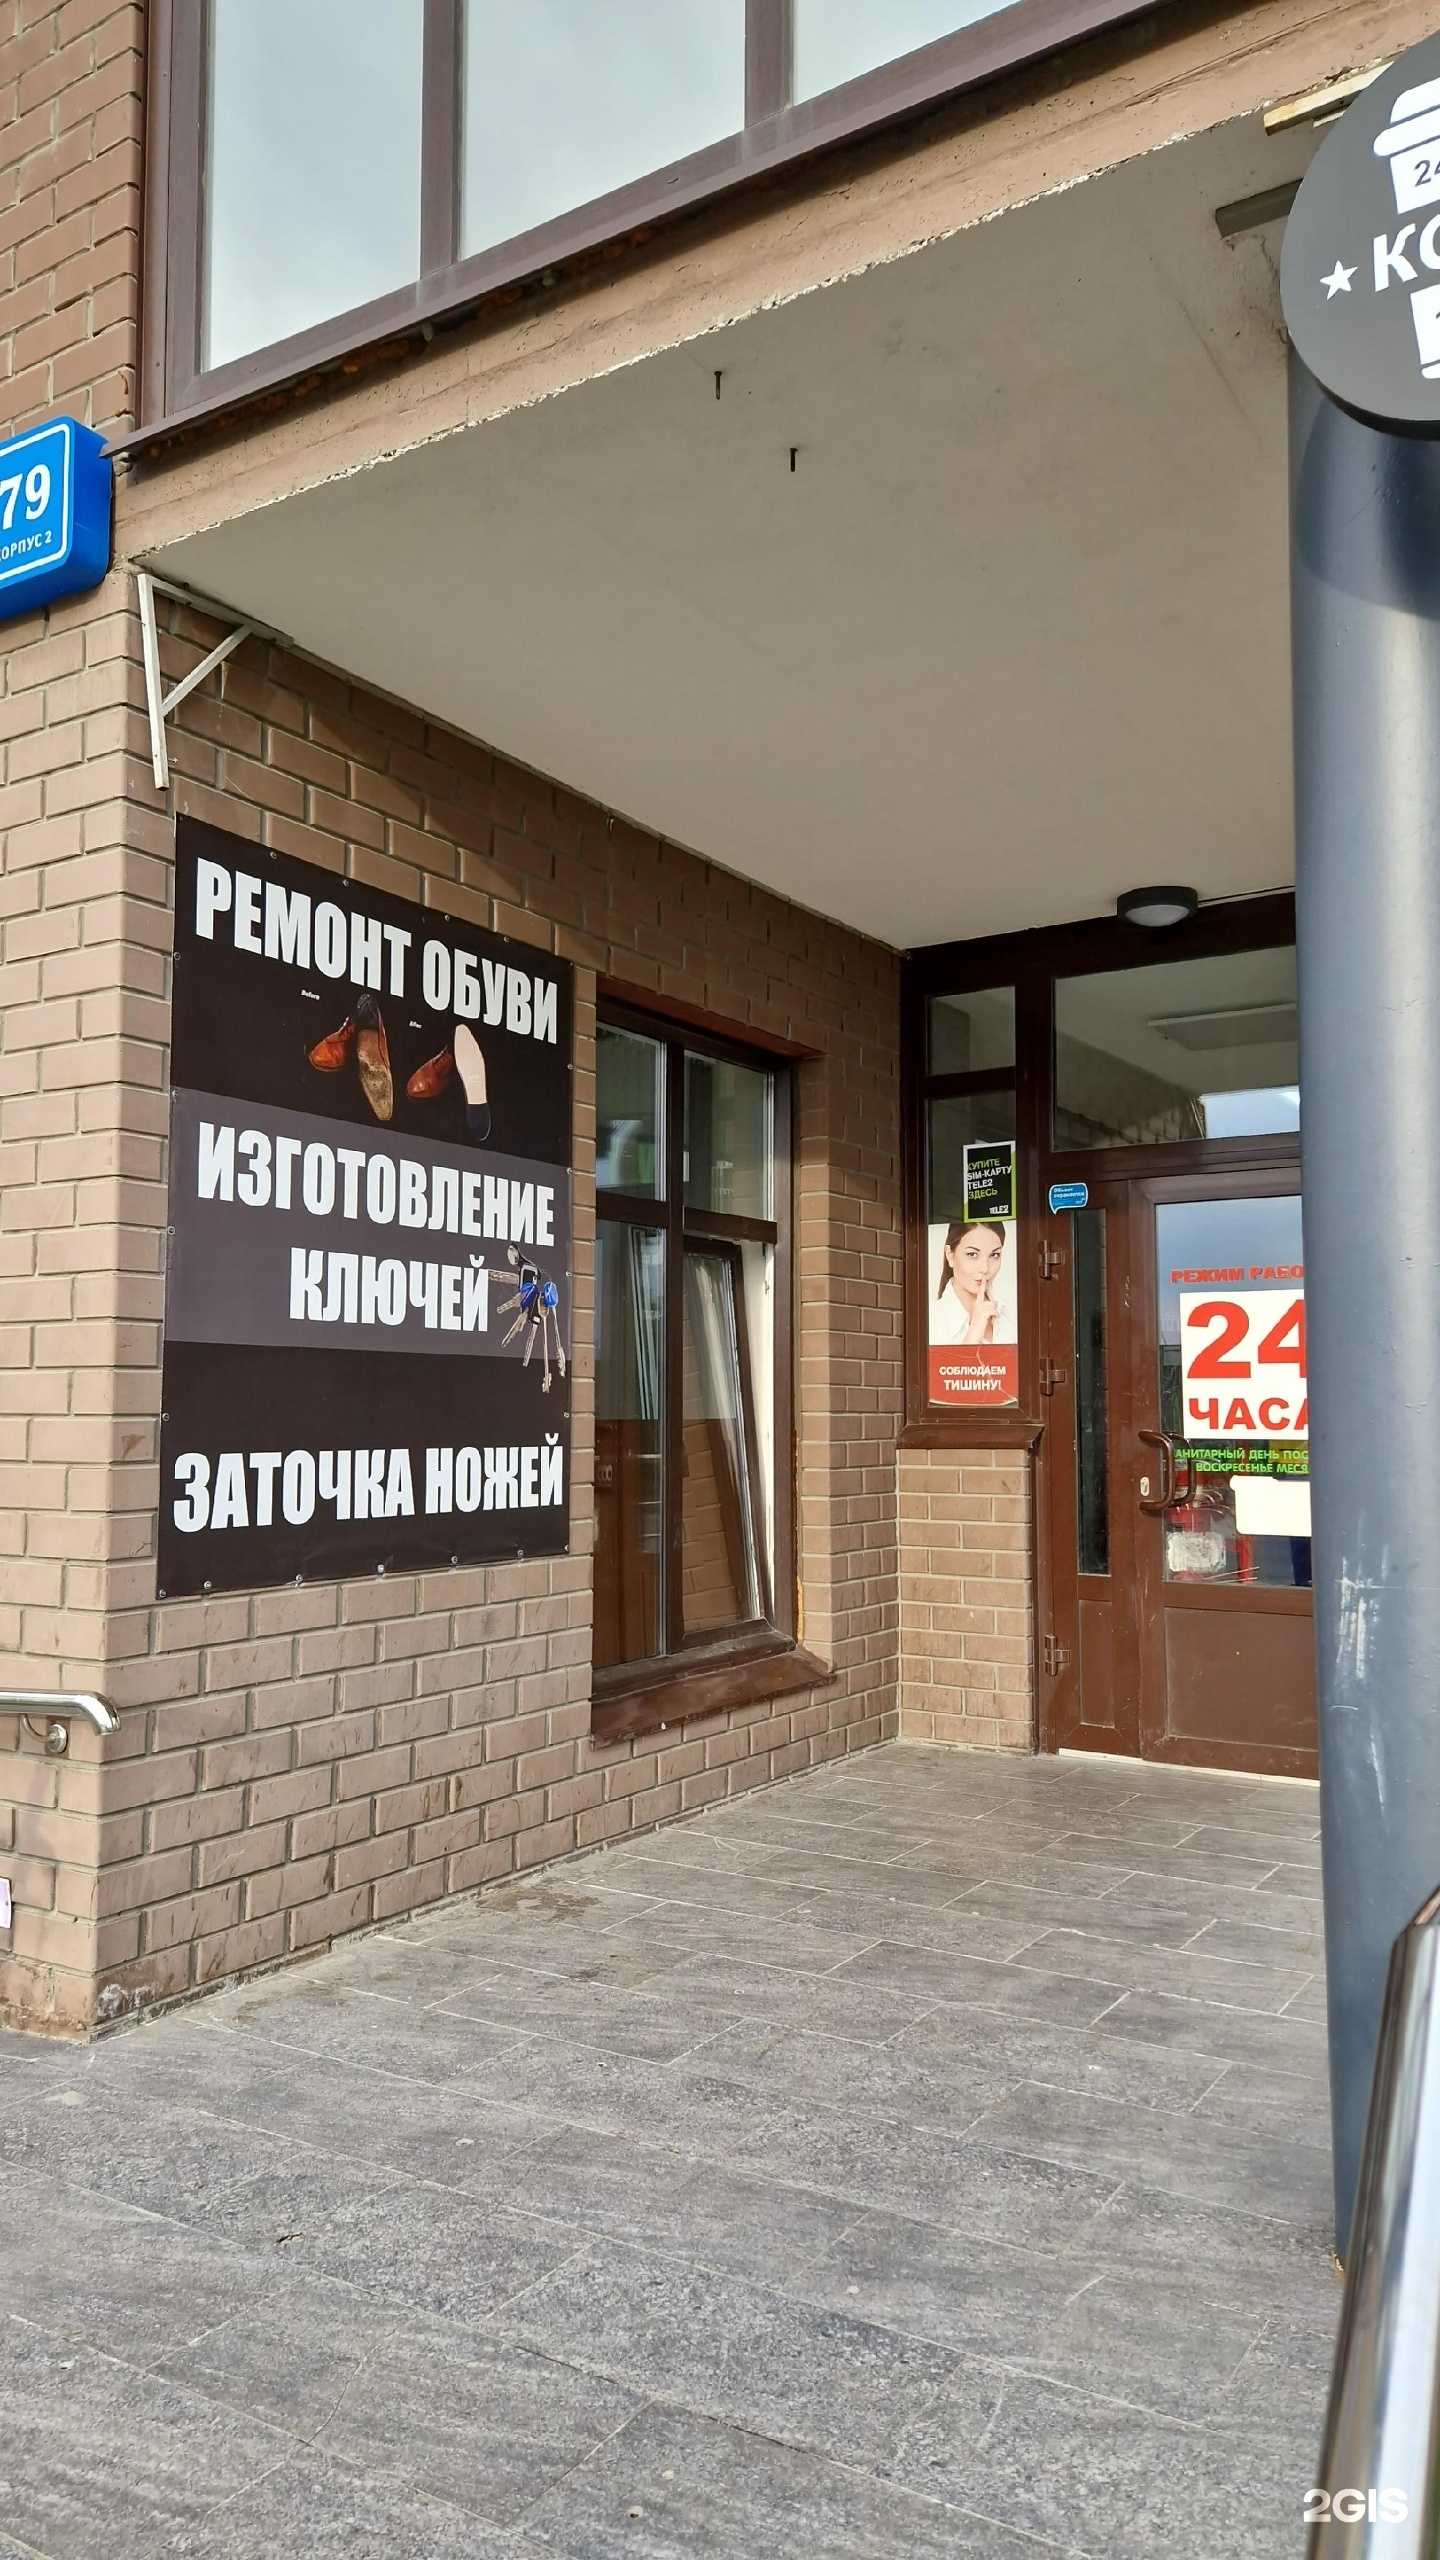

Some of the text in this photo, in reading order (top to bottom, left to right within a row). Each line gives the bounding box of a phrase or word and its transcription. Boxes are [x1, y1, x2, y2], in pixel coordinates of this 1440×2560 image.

[0, 530, 52, 561] ОРПУС 2
[196, 857, 558, 1045] РЕМОНТ ОБУВИ
[197, 1121, 555, 1247] ИЗГОТОВЛЕНИЕ
[968, 1179, 993, 1190] TELE2
[968, 1188, 998, 1200] ЗДЕСЬ
[1170, 1266, 1244, 1284] РЕЖИМ
[289, 1247, 489, 1332] КЛЮЧЕЙ
[1187, 1299, 1306, 1380] 24
[939, 1366, 1006, 1377] СОБЛЮДАЕМ
[1249, 1449, 1280, 1460] ДЕНЬ
[1196, 1462, 1273, 1473] ВОСКРЕСЕНЬЕ
[173, 1433, 564, 1533] ЗАТОЧКА НОЖЕЙ
